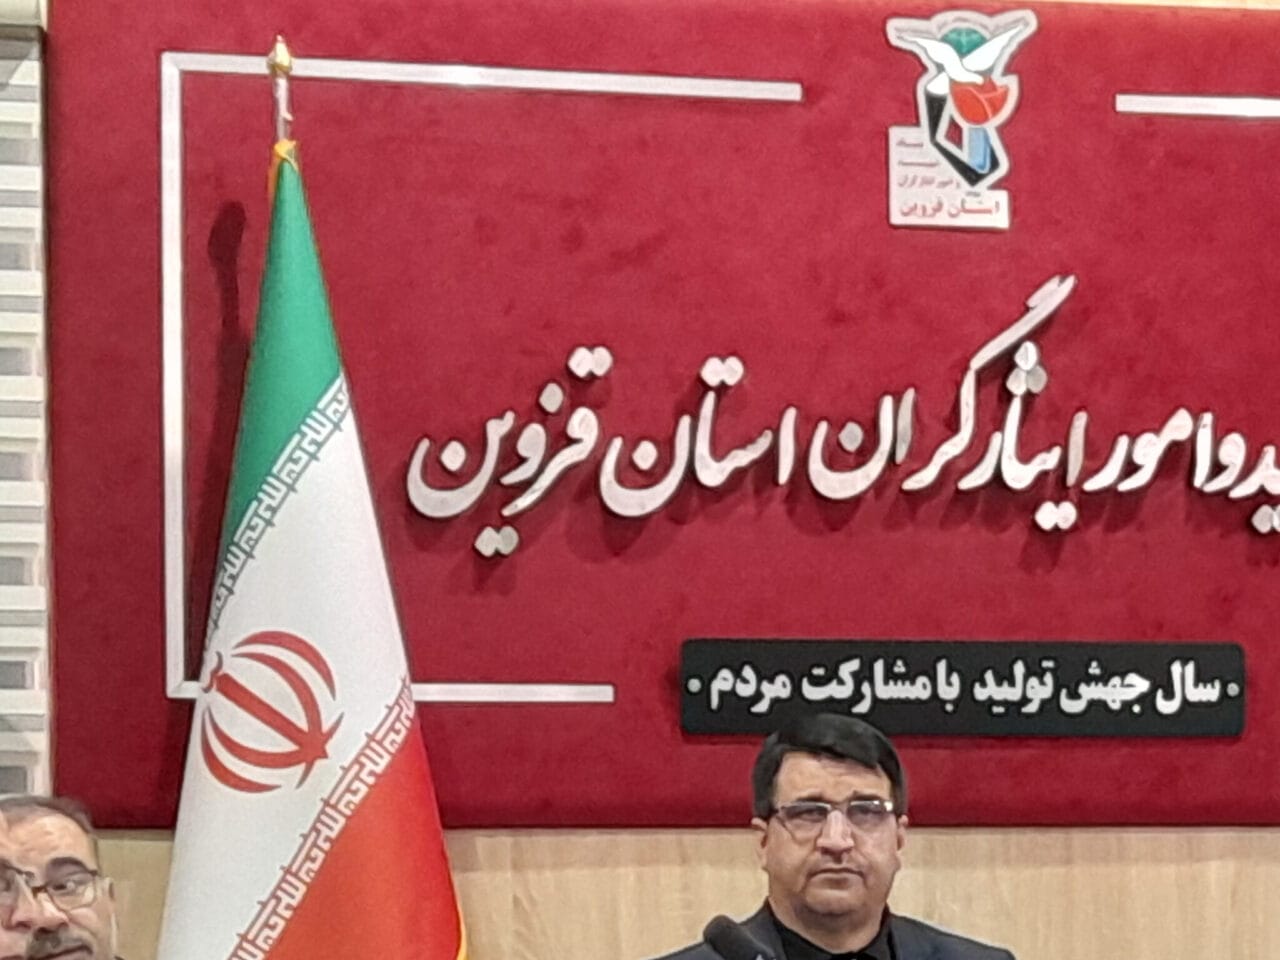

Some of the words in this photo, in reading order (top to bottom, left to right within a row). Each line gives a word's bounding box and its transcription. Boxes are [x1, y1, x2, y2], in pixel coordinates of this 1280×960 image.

[808, 274, 1088, 532] ایثارگران
[407, 346, 613, 557] قزوین
[600, 356, 797, 517] استان
[1084, 408, 1213, 492] امور
[1204, 433, 1246, 493] و
[709, 663, 792, 714] مردم
[801, 658, 933, 713] مشارکت
[932, 659, 961, 712] با
[973, 660, 1055, 714] تولید
[1059, 660, 1151, 713] جهش
[1156, 660, 1222, 714] سال
